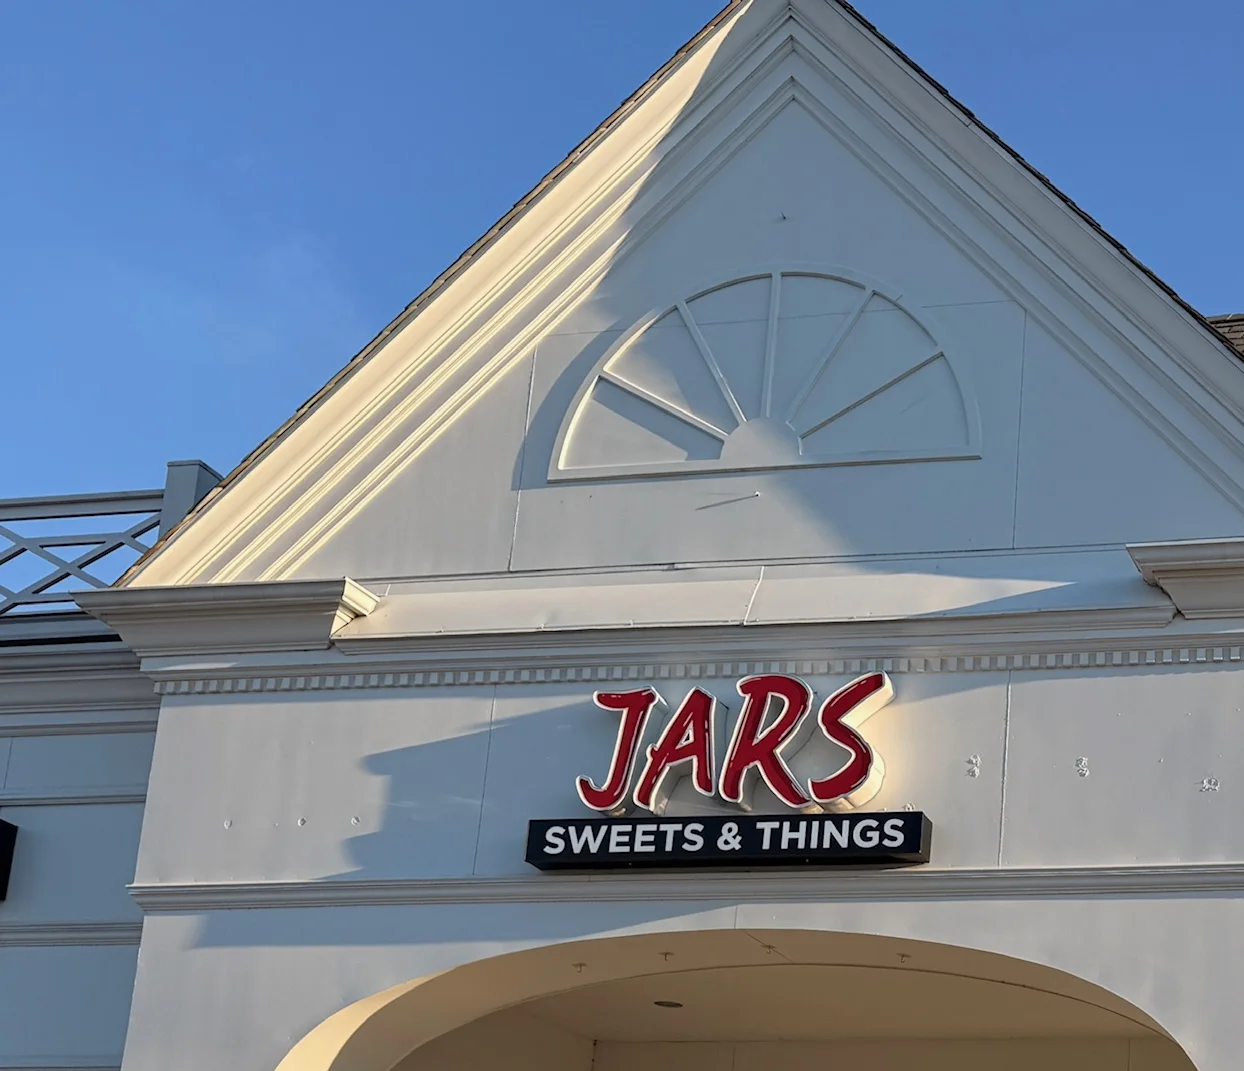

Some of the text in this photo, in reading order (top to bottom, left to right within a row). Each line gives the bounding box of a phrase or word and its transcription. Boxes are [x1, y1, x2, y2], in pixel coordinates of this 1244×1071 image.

[576, 671, 890, 811] JARS
[543, 818, 905, 854] SWEETS & THINGS
